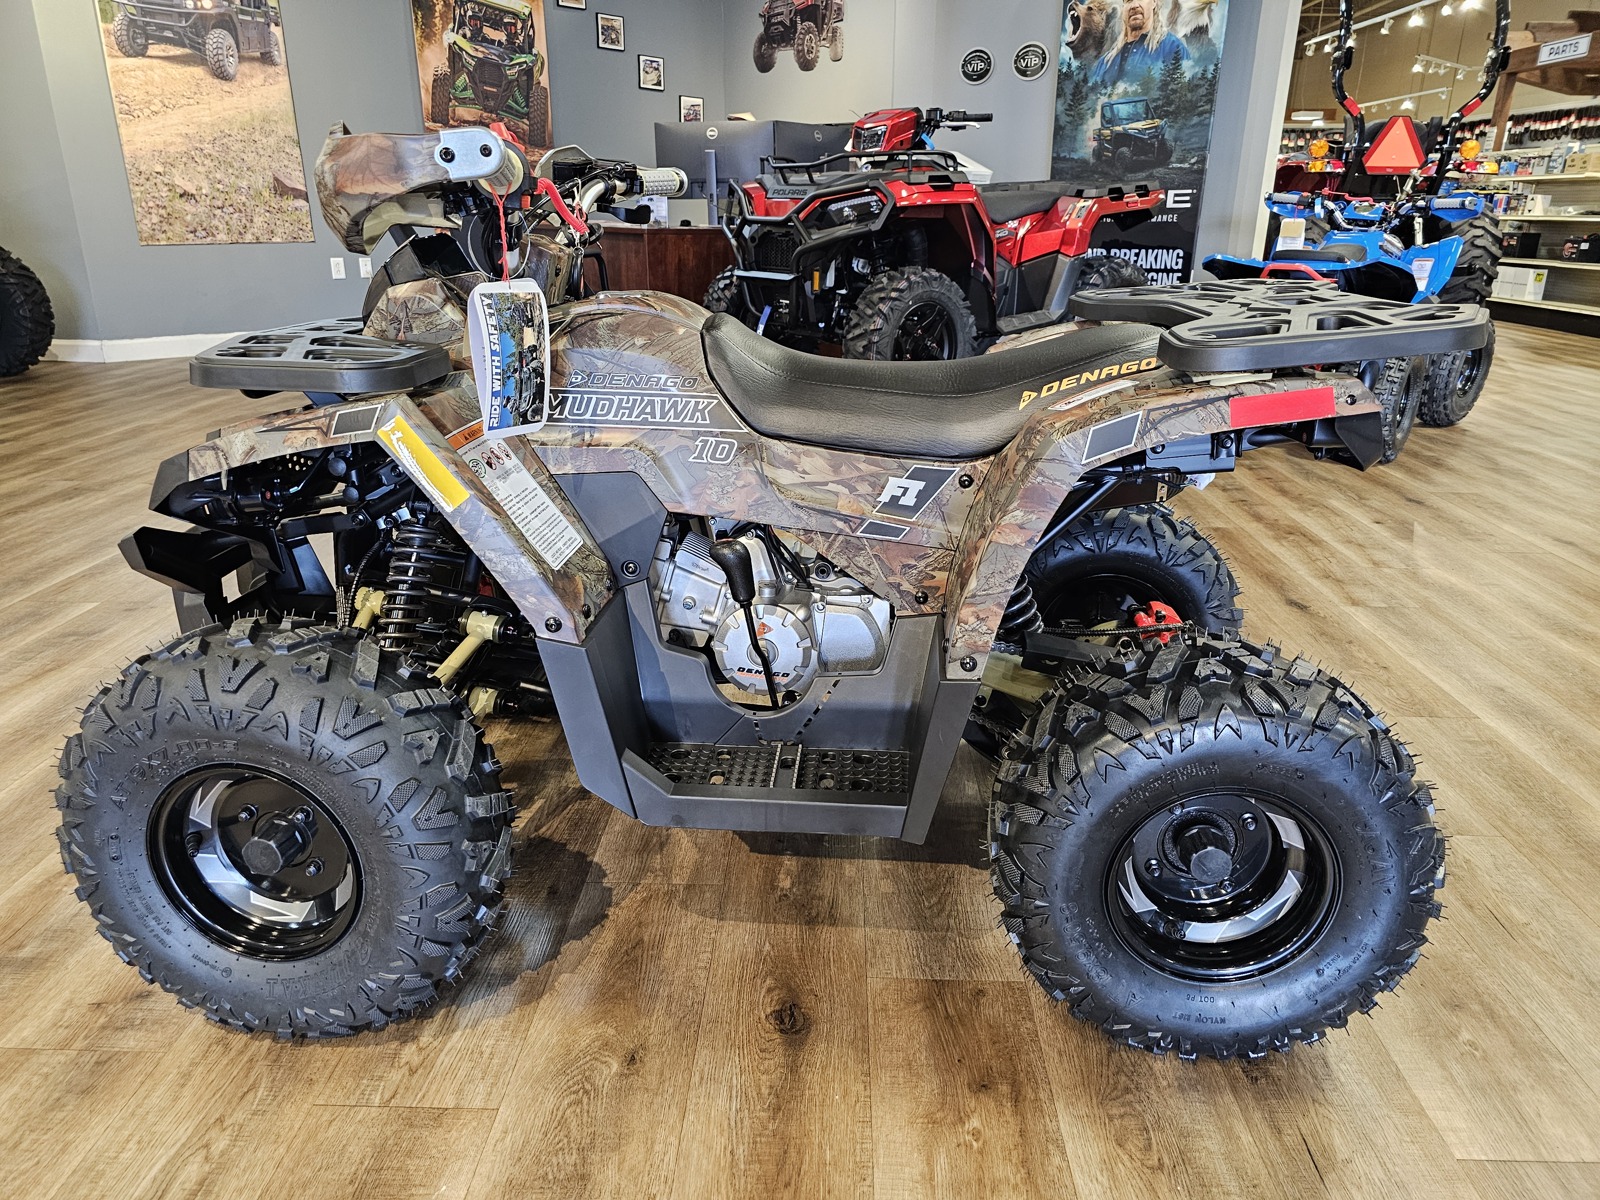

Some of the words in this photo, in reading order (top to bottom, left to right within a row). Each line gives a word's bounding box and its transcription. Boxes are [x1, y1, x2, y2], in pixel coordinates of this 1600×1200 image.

[1548, 41, 1580, 58] PARTS
[967, 62, 985, 72] VIP
[1020, 57, 1039, 68] VIP
[771, 188, 809, 197] POLARIS
[480, 295, 501, 353] SAFETY
[490, 355, 502, 394] WITH
[588, 372, 700, 390] DENAGO
[1040, 357, 1158, 399] DENAGO
[489, 396, 502, 428] RIDE
[547, 393, 720, 425] MUDHAWK
[688, 436, 738, 465] 10
[736, 666, 791, 678] DENGO
[1198, 994, 1215, 1004] DOT
